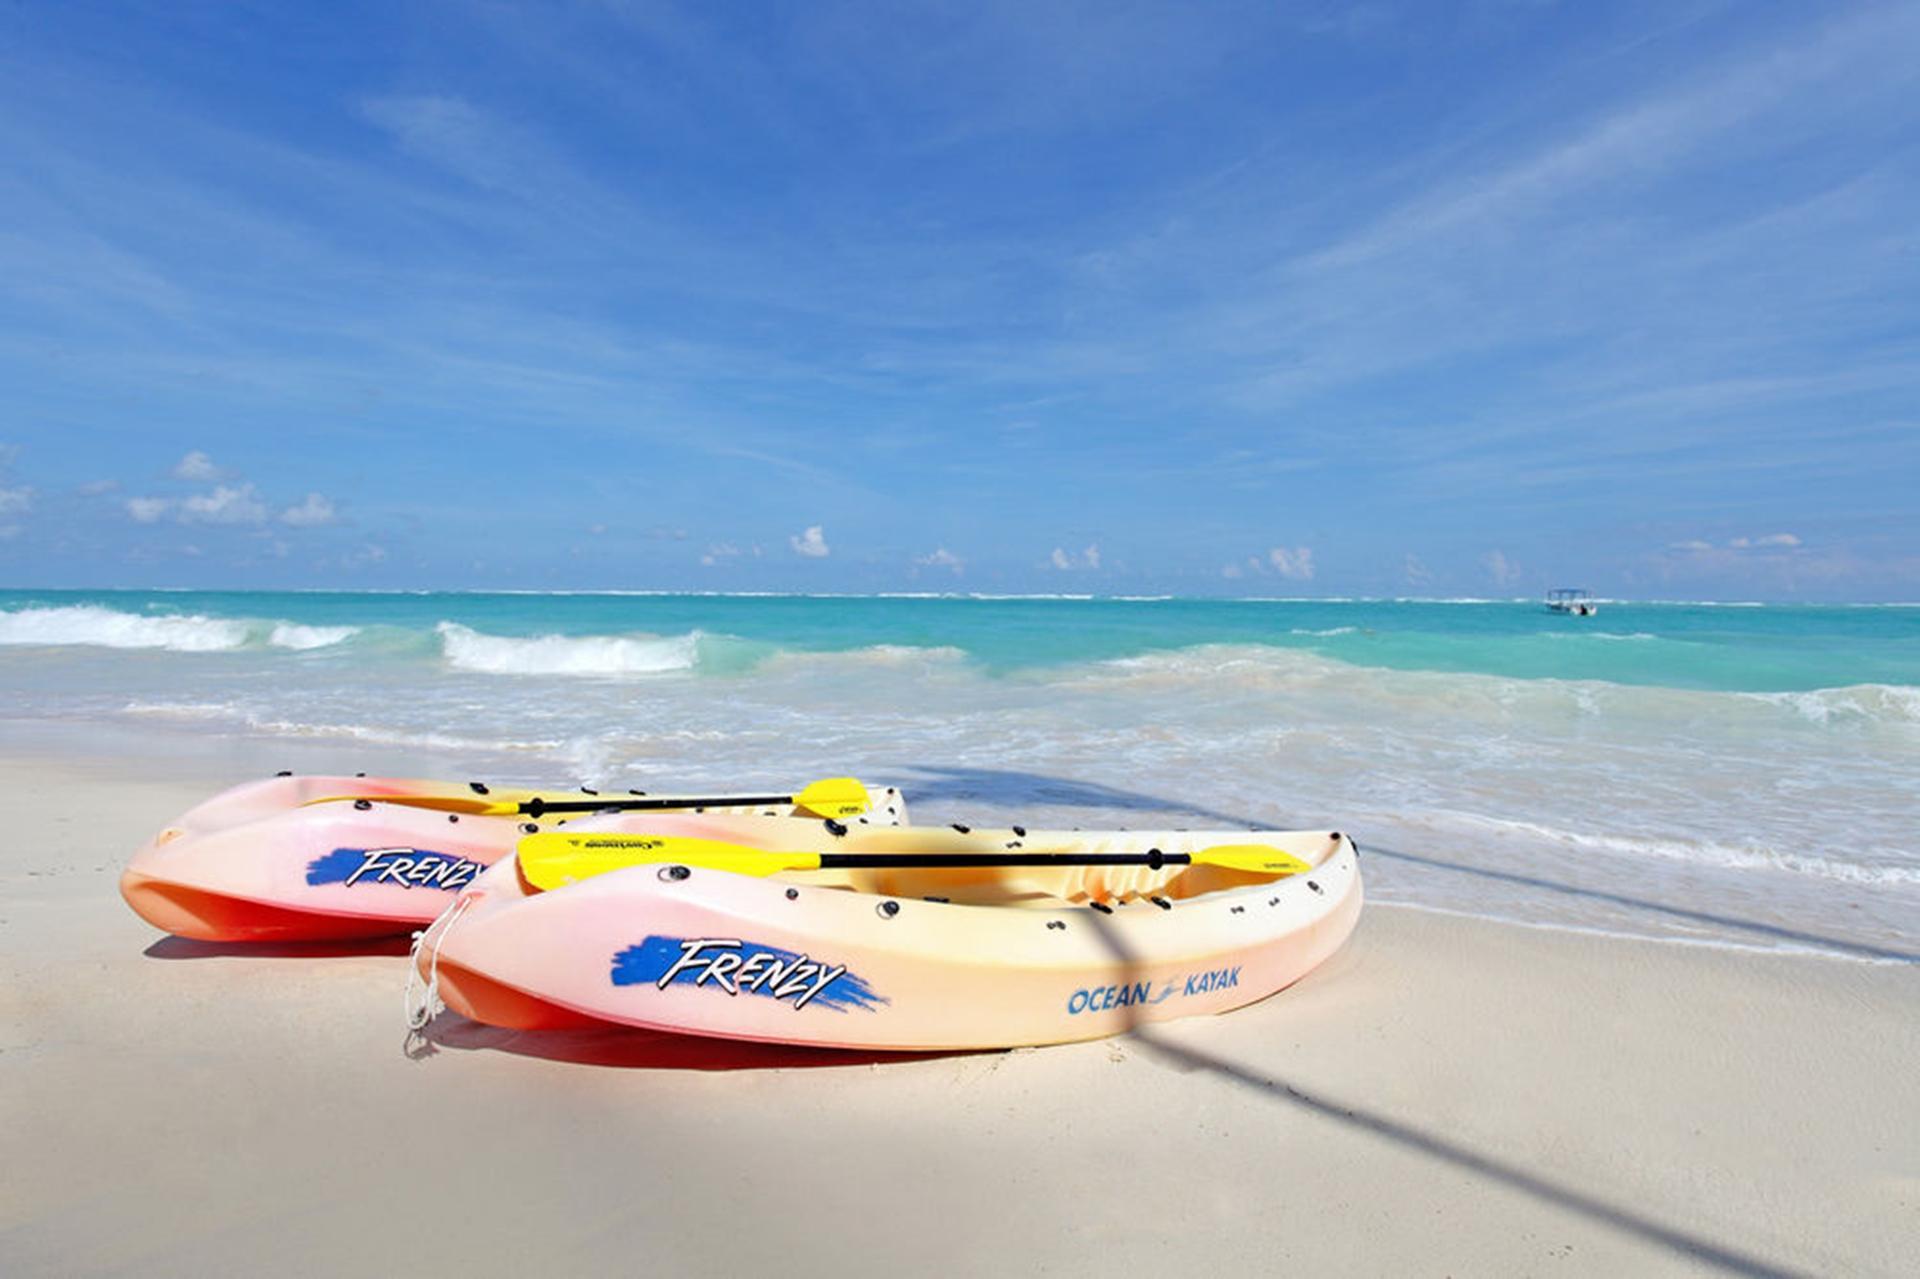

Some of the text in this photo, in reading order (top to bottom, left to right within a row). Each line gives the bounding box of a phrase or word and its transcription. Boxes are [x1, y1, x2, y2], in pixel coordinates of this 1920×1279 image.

[656, 937, 847, 1010] FRENZY
[1068, 965, 1242, 1014] OCEAN KAYAK
